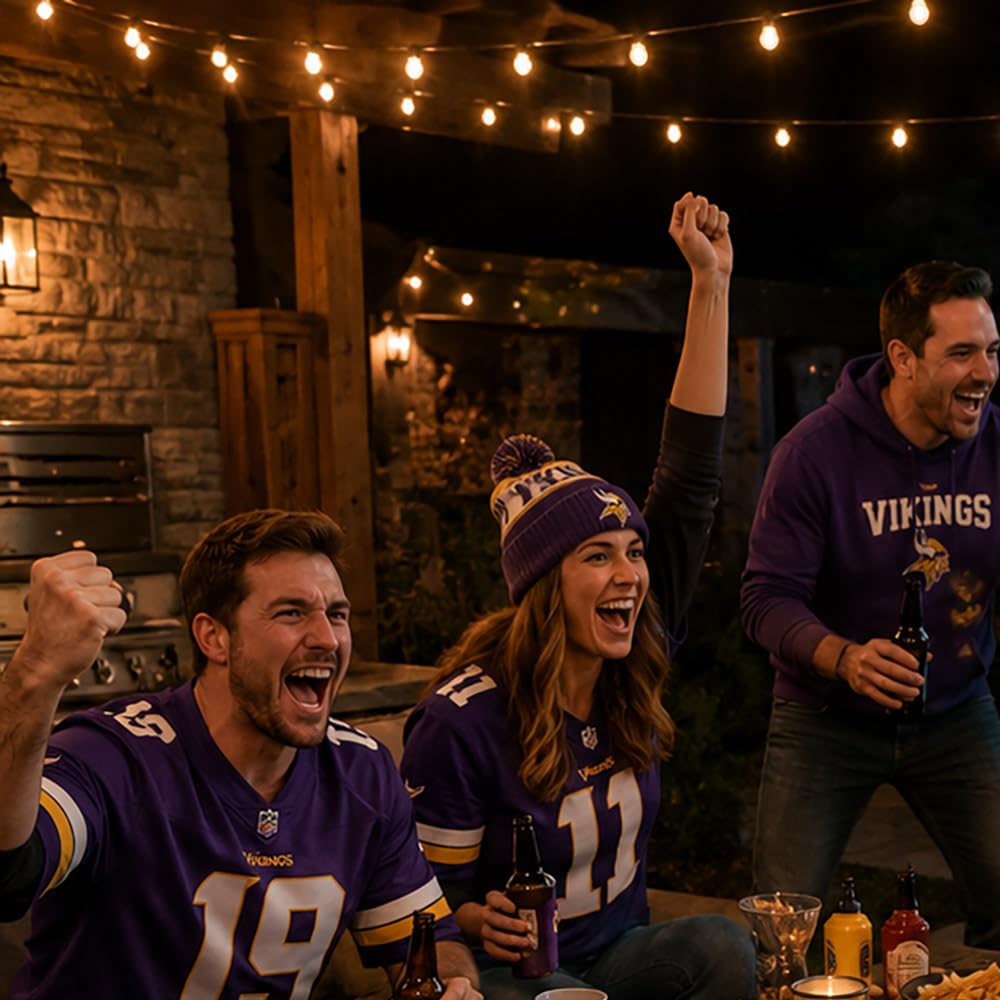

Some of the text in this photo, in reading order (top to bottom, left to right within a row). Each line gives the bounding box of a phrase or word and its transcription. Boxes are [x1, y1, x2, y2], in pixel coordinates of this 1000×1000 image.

[862, 494, 991, 536] VIKINGS
[436, 663, 497, 708] 11
[557, 768, 643, 920] 11
